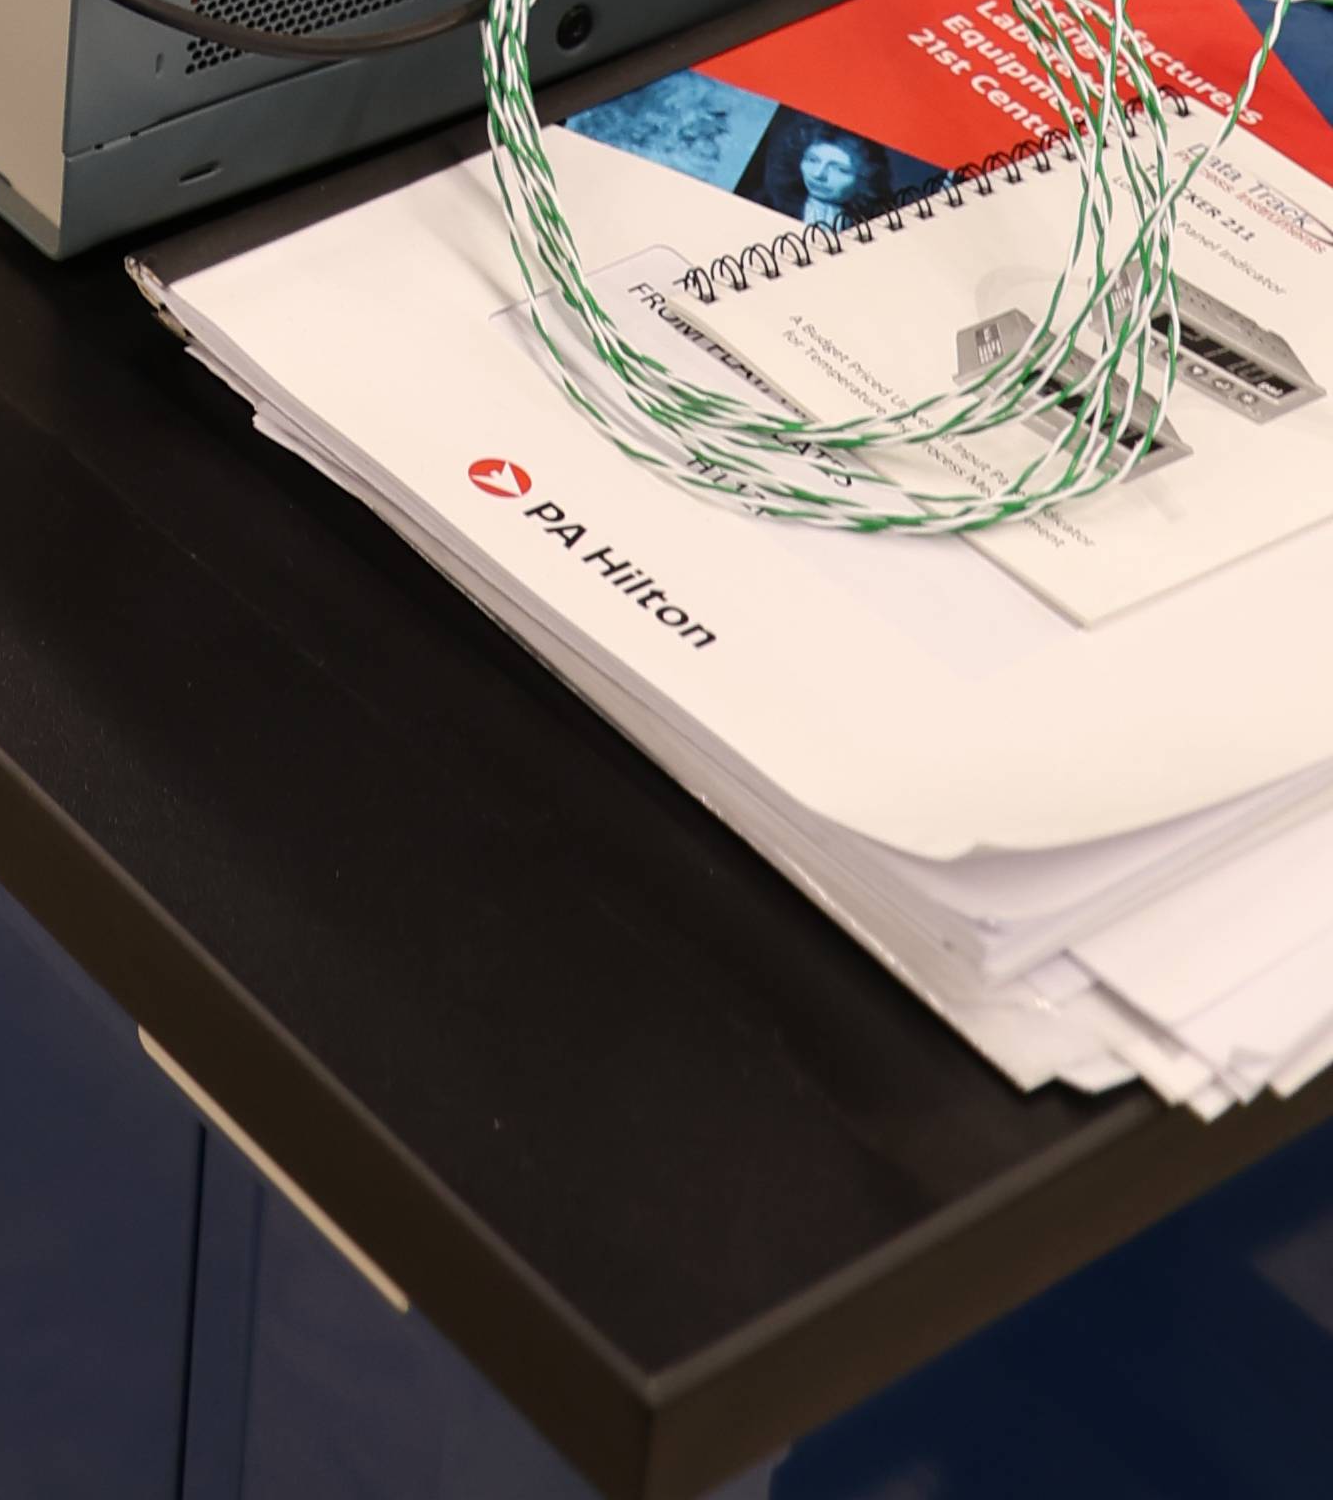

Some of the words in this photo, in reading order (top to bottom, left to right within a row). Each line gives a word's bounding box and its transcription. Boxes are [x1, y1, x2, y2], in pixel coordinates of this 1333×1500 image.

[907, 27, 971, 75] 21st
[1248, 181, 1309, 228] Track
[1221, 217, 1255, 242] 211
[523, 501, 587, 549] PA
[582, 546, 716, 649] Hilton
